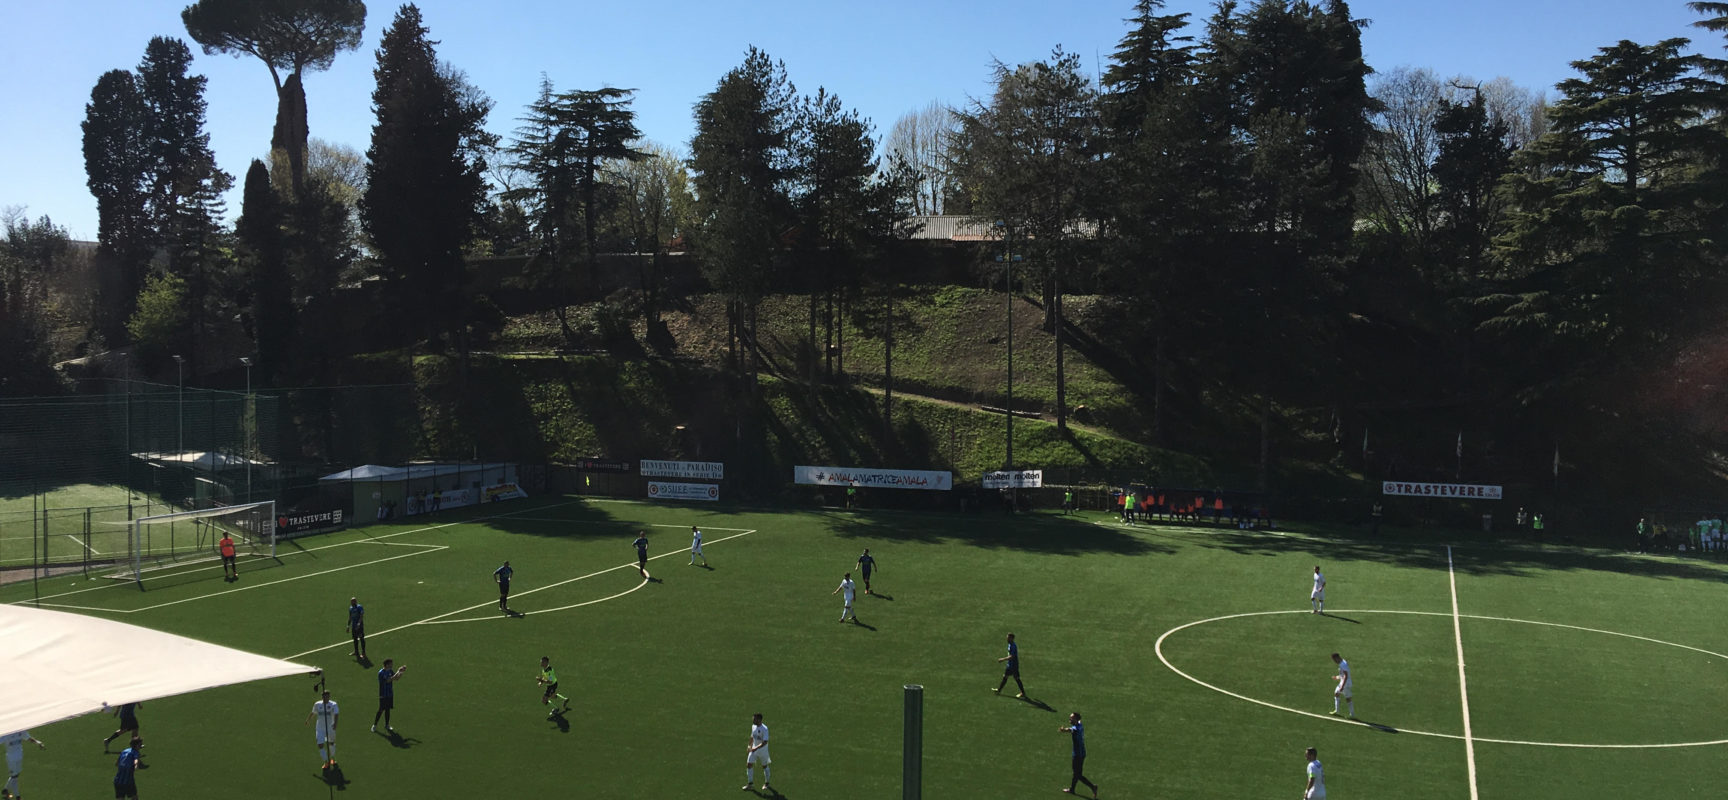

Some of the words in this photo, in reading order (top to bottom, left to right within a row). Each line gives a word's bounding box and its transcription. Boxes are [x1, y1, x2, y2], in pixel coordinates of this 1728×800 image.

[686, 463, 722, 472] PARADISO
[828, 472, 929, 486] AMALAMATRICEAMALA
[985, 473, 1010, 481] molten
[1015, 472, 1040, 480] molten
[1397, 483, 1484, 497] TRASTEVERE
[289, 513, 331, 526] TRASTEVERE
